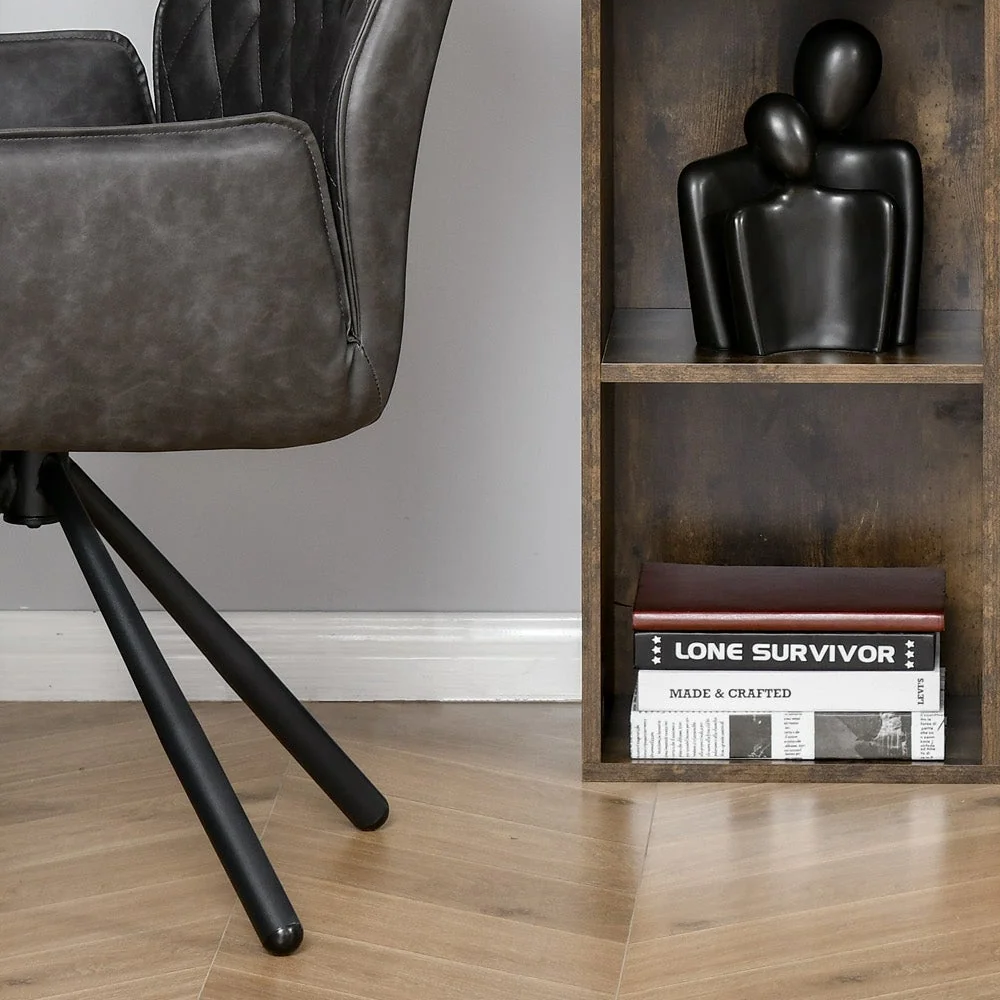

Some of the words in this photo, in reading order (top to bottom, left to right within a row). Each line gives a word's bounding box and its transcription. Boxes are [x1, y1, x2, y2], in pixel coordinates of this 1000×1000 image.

[675, 642, 743, 661] LONE
[752, 643, 896, 664] SURVIVOR
[669, 688, 711, 699] MADE
[714, 688, 725, 699] &
[728, 688, 792, 699] CRAFTED
